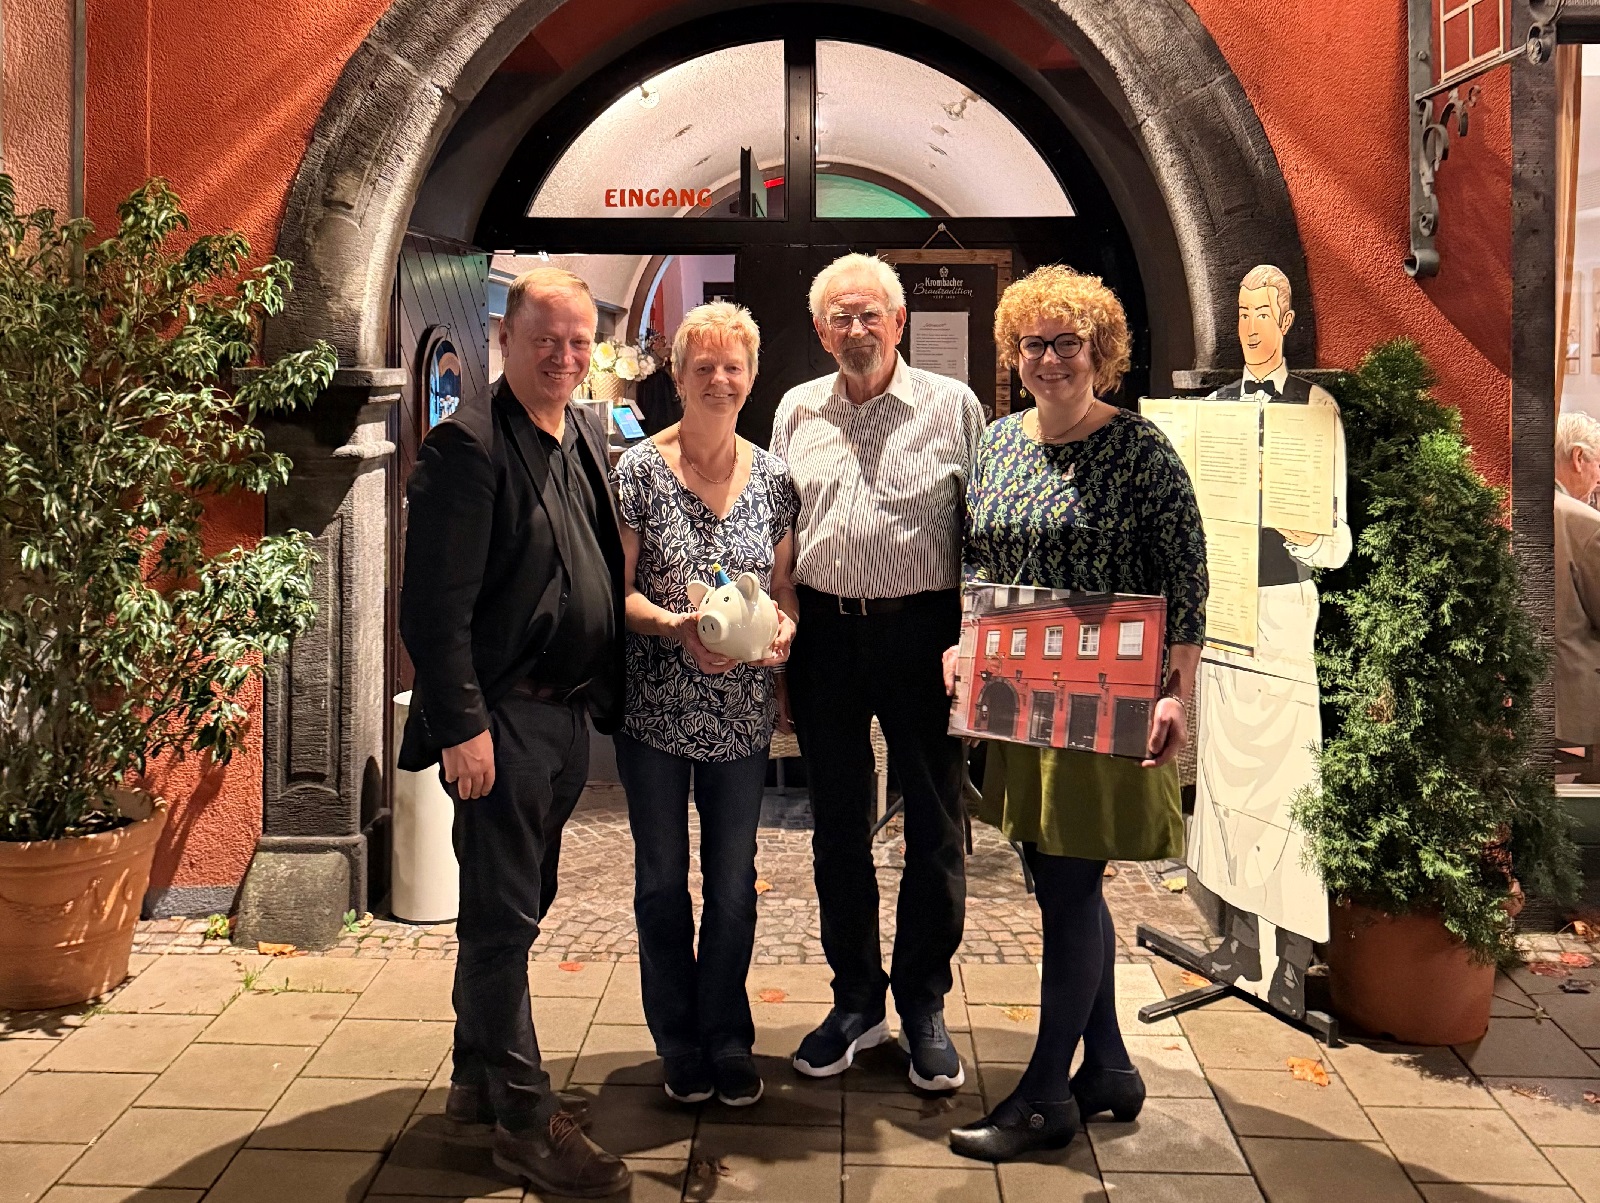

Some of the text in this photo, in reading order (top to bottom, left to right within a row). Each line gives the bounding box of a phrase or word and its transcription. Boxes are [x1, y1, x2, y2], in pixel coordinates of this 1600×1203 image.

[605, 188, 712, 207] EINGANG
[925, 277, 963, 286] Krombacher
[913, 283, 973, 297] Brautradition
